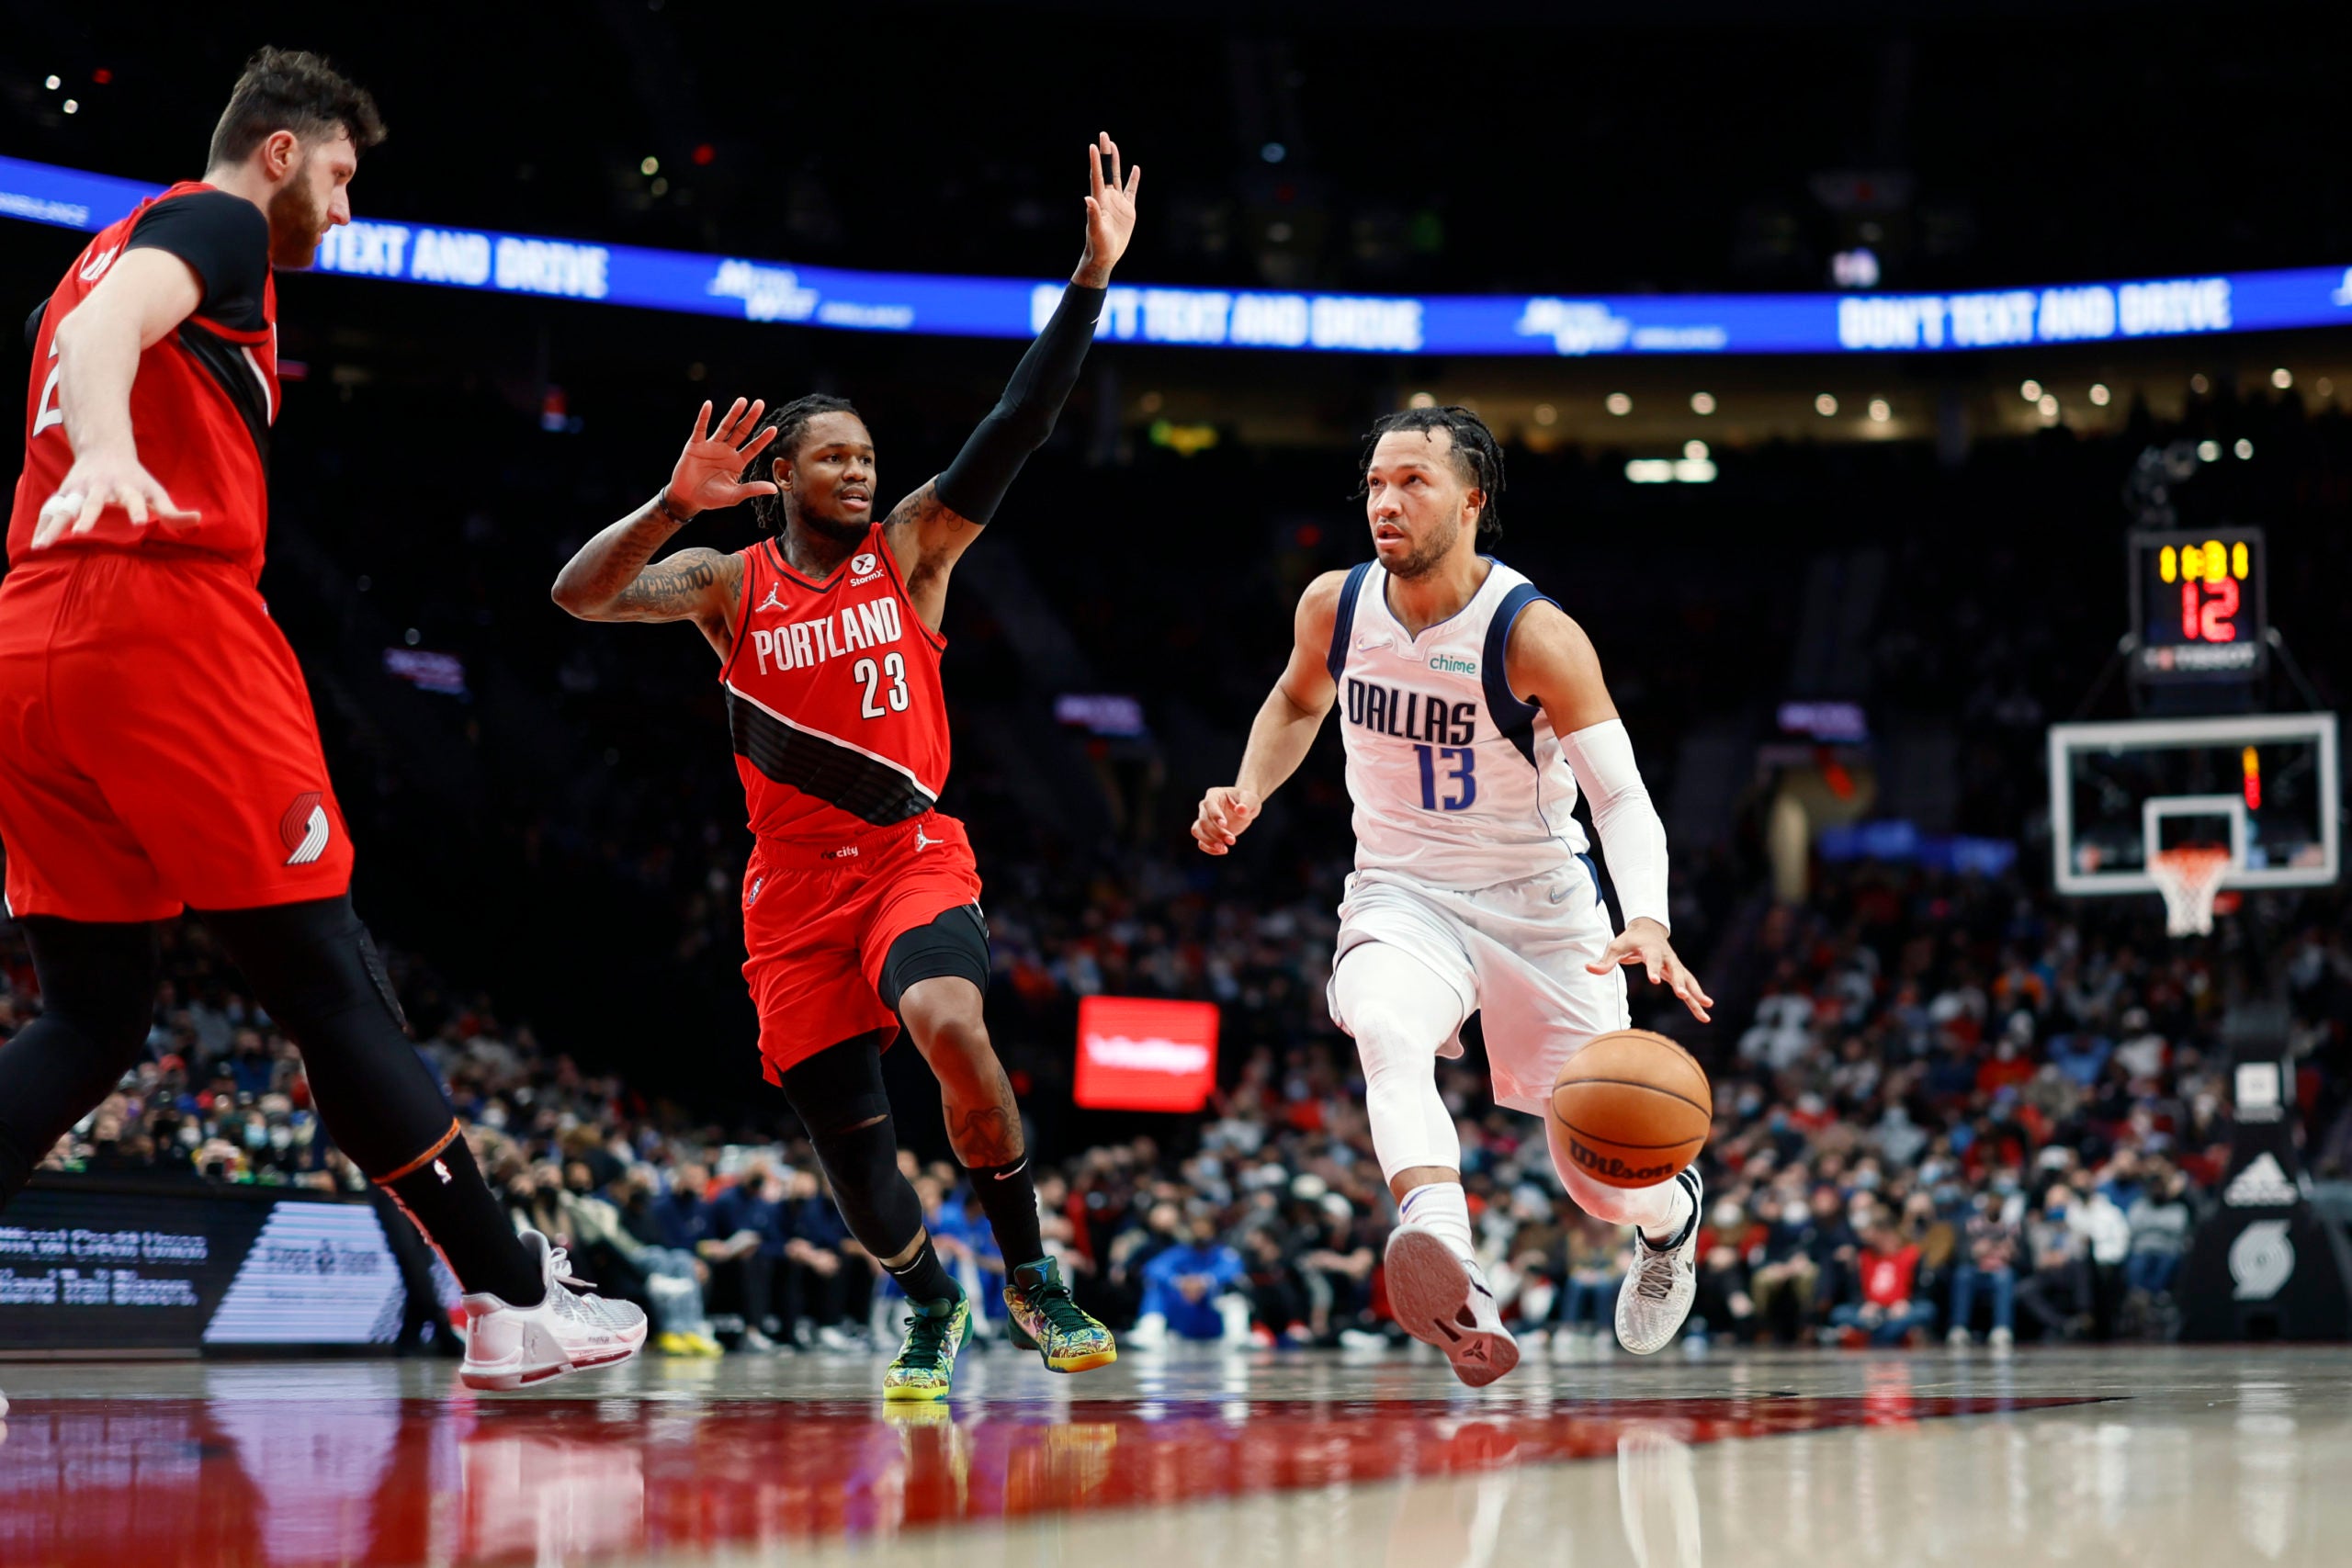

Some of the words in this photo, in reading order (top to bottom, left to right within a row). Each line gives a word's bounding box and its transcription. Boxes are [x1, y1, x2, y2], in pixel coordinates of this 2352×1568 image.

[321, 220, 410, 277] TEXT
[411, 229, 491, 286] AND
[495, 236, 610, 299] DRIVE
[1142, 288, 1232, 344] TEXT
[1230, 293, 1308, 348] AND
[1309, 296, 1424, 352] DRIVE
[1838, 296, 1945, 350] DON'T
[1951, 290, 2037, 346] TEXT
[2037, 286, 2114, 342] AND
[2118, 277, 2232, 336] DRIVE
[850, 570, 885, 587] StormX
[2182, 576, 2240, 642] 12
[750, 596, 902, 675] PORTLAND
[1430, 655, 1476, 674] chime
[853, 651, 910, 719] 23
[1347, 676, 1477, 746] DALLAS
[1412, 743, 1477, 811] 13
[1570, 1135, 1674, 1179] Wilson
